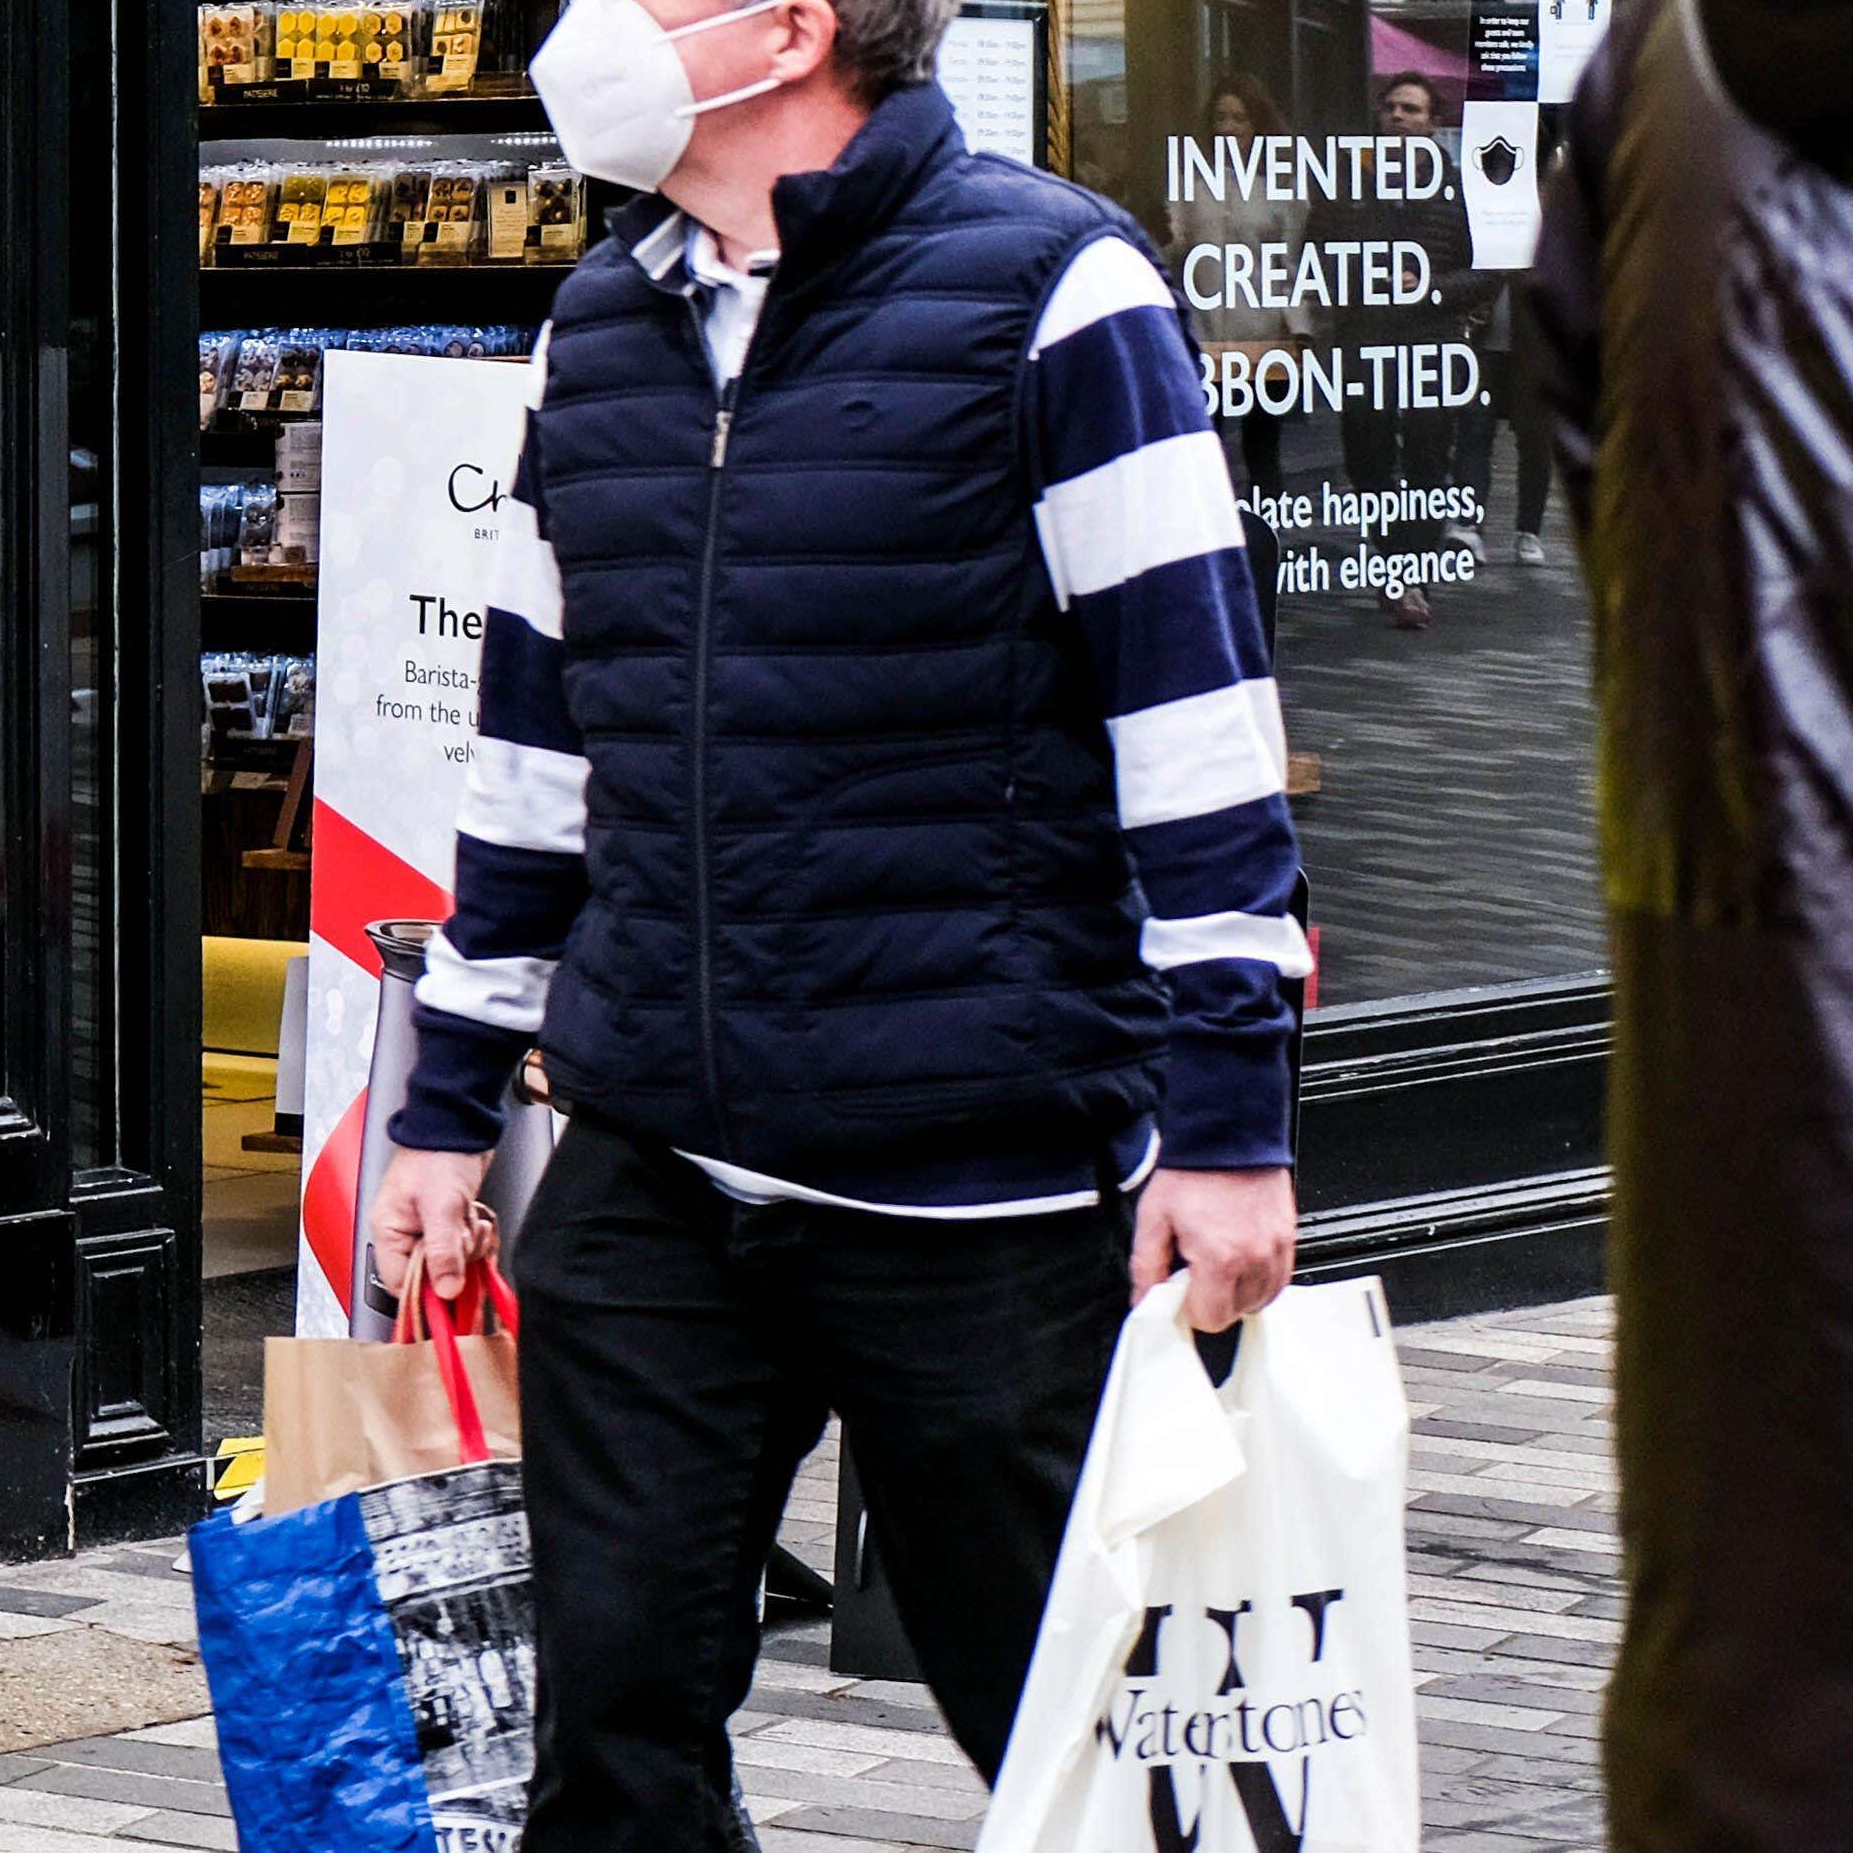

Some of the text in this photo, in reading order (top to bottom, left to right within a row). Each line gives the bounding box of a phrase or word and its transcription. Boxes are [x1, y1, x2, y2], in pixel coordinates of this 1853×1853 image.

[1167, 135, 1454, 201] INVENTED.
[1183, 241, 1442, 310] CREATED.
[1322, 479, 1485, 537] happiness,
[1340, 543, 1475, 600] elegance
[409, 594, 483, 640] The
[405, 660, 481, 695] Barista-
[376, 694, 422, 720] from
[430, 701, 460, 725] the
